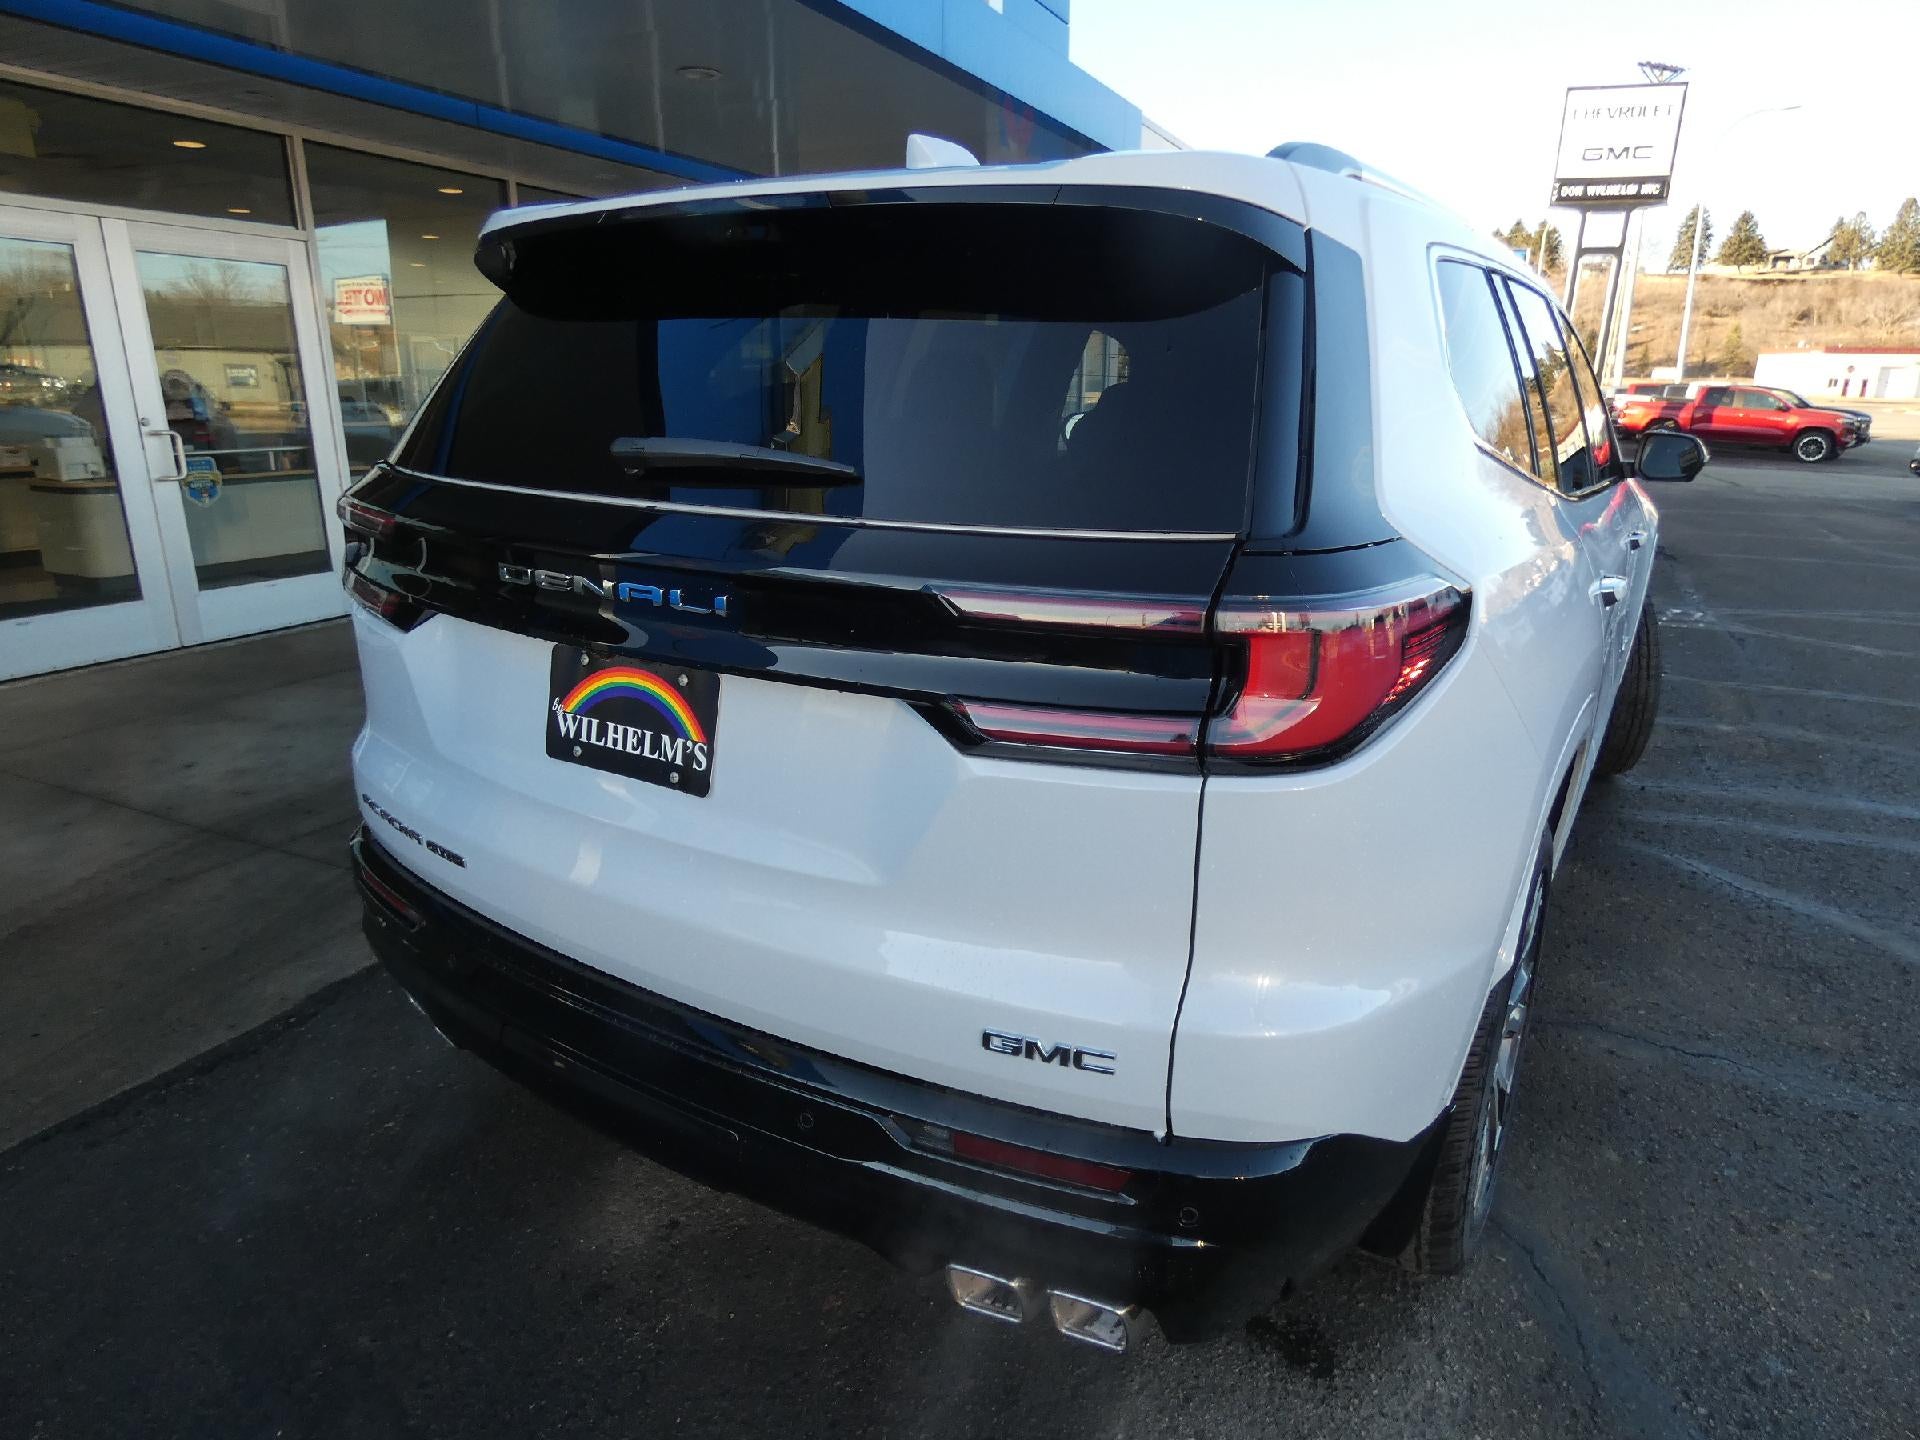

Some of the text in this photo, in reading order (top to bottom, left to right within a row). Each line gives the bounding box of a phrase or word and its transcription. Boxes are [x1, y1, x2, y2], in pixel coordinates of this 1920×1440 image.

[1582, 145, 1654, 161] GMC
[498, 562, 727, 617] DENALI
[556, 712, 708, 771] WILHELM'S
[982, 1026, 1117, 1075] GMC
